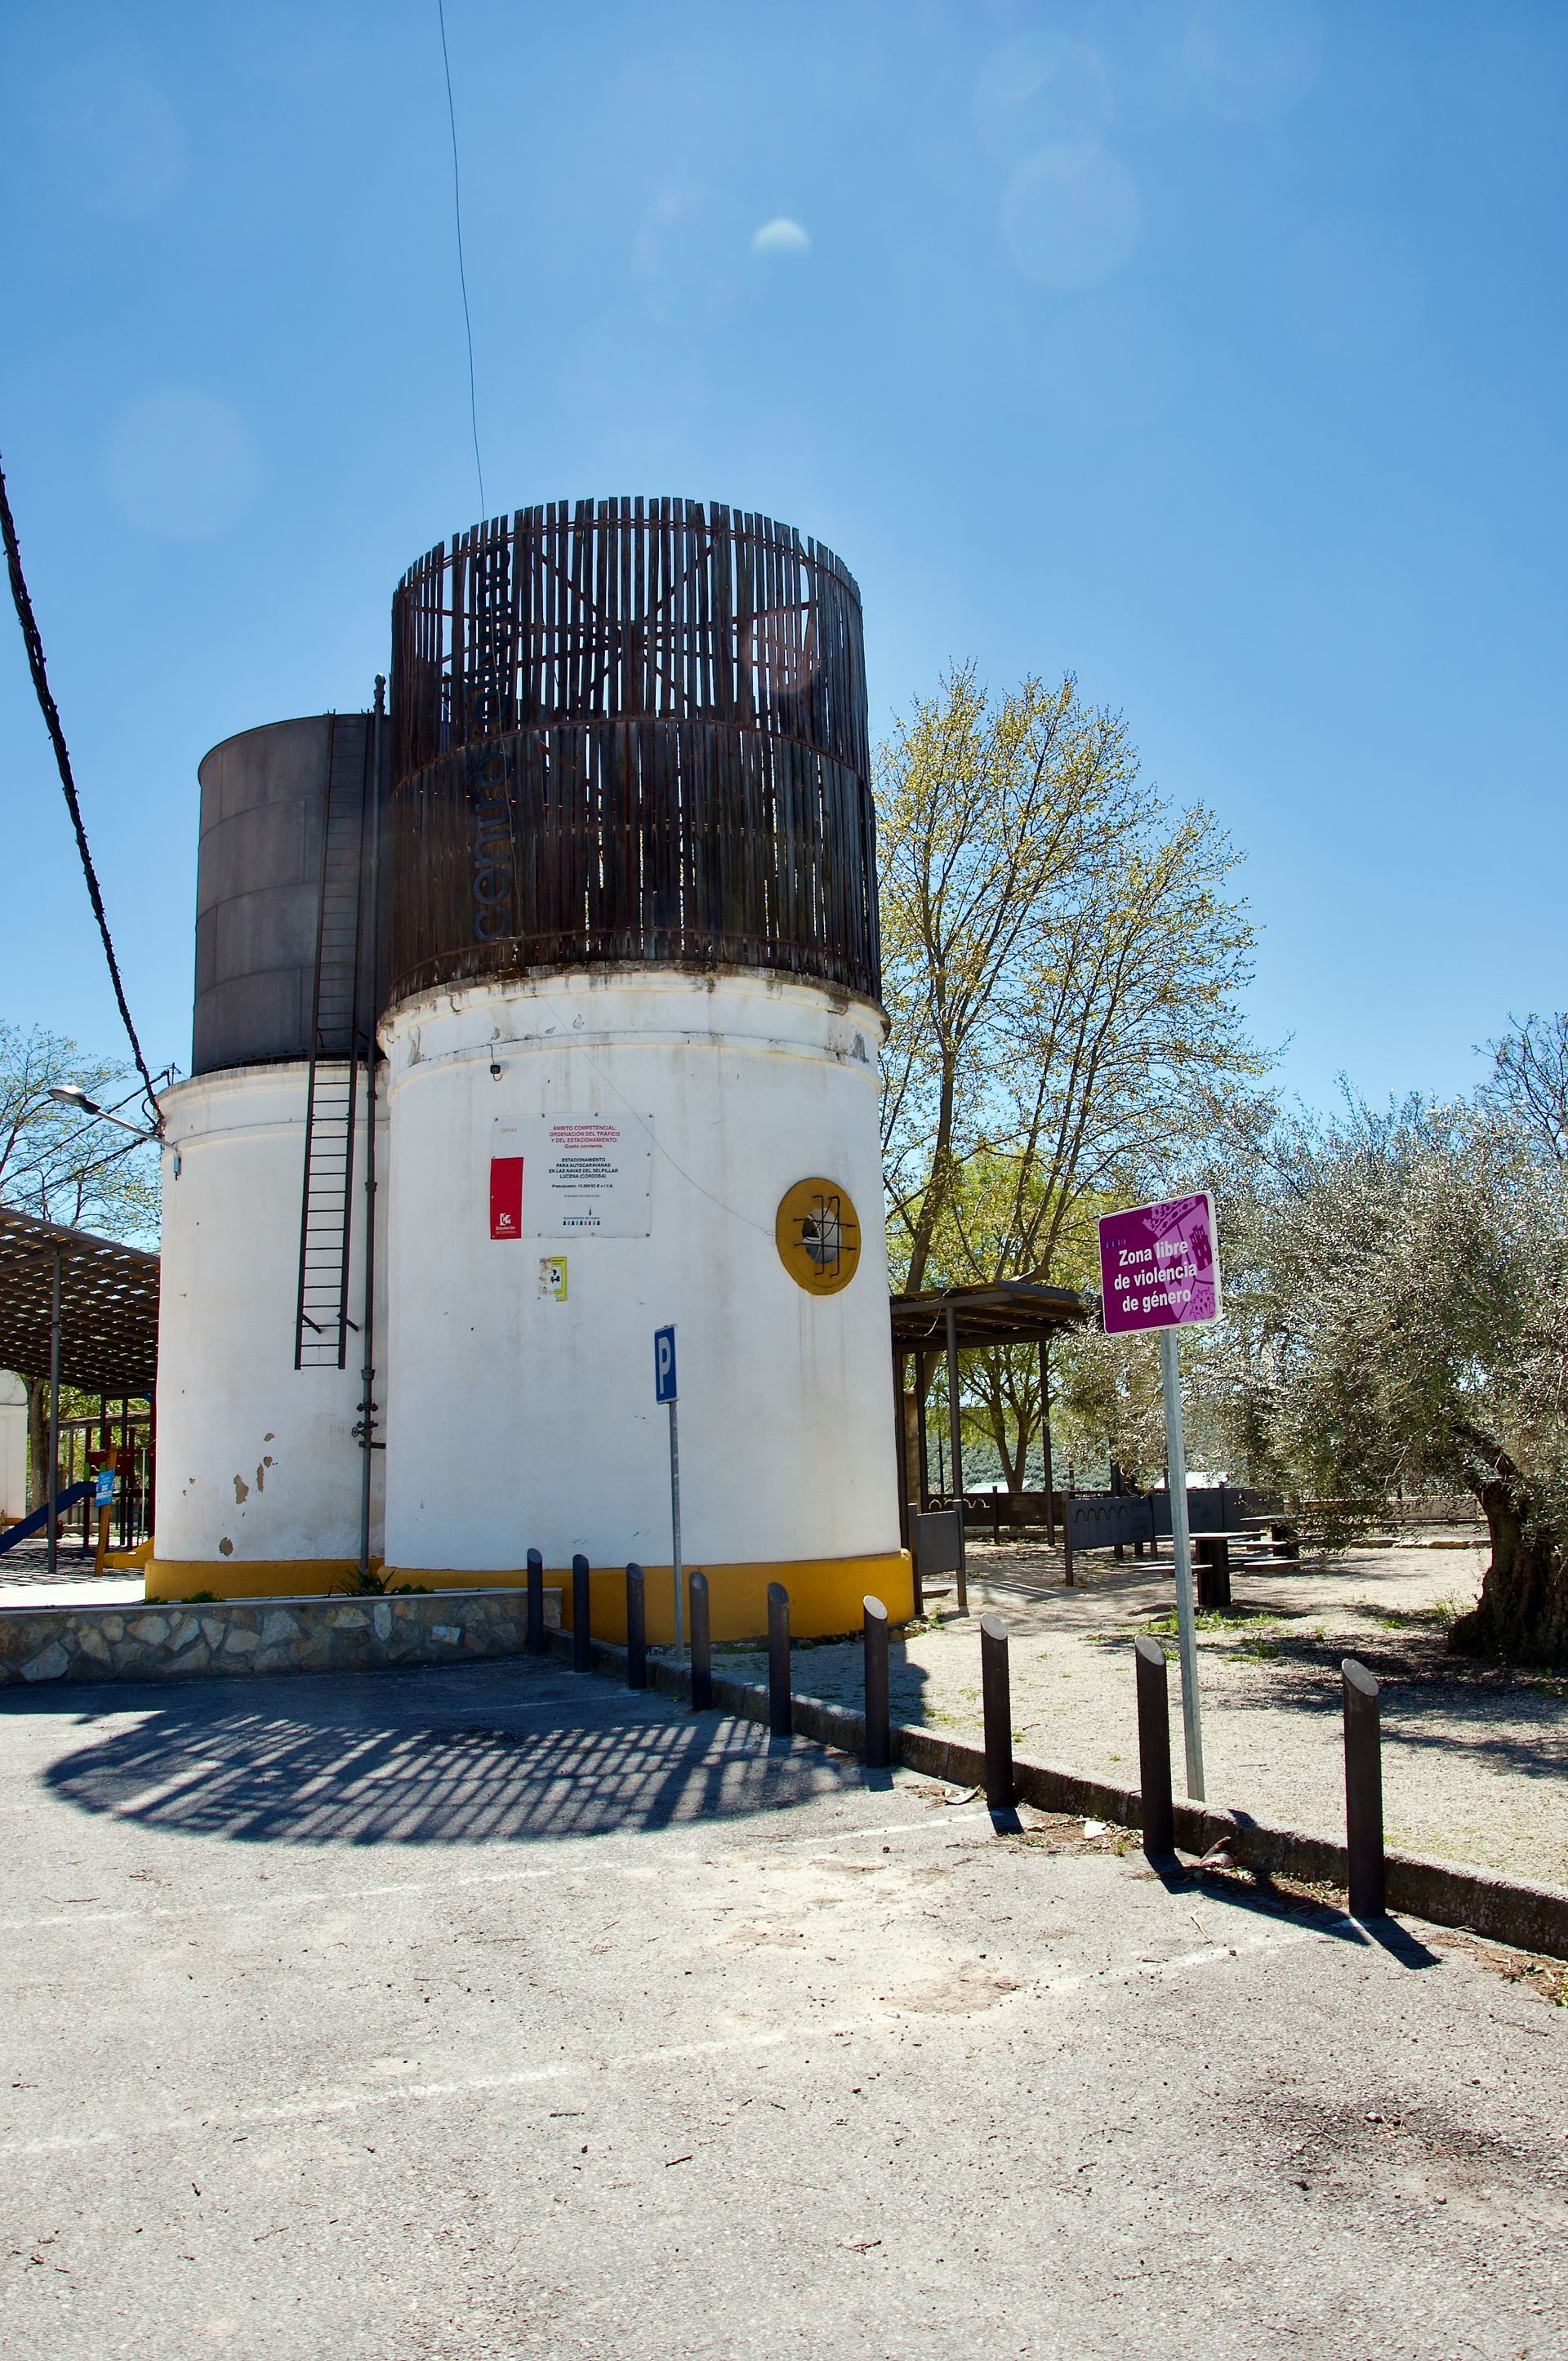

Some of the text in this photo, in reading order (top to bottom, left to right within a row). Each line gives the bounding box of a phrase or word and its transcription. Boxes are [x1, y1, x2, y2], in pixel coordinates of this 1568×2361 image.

[472, 749, 512, 941] centro
[1119, 1241, 1188, 1267] Zona libre
[1114, 1261, 1198, 1290] de violencia
[1122, 1289, 1192, 1313] de género
[657, 1336, 671, 1395] P
